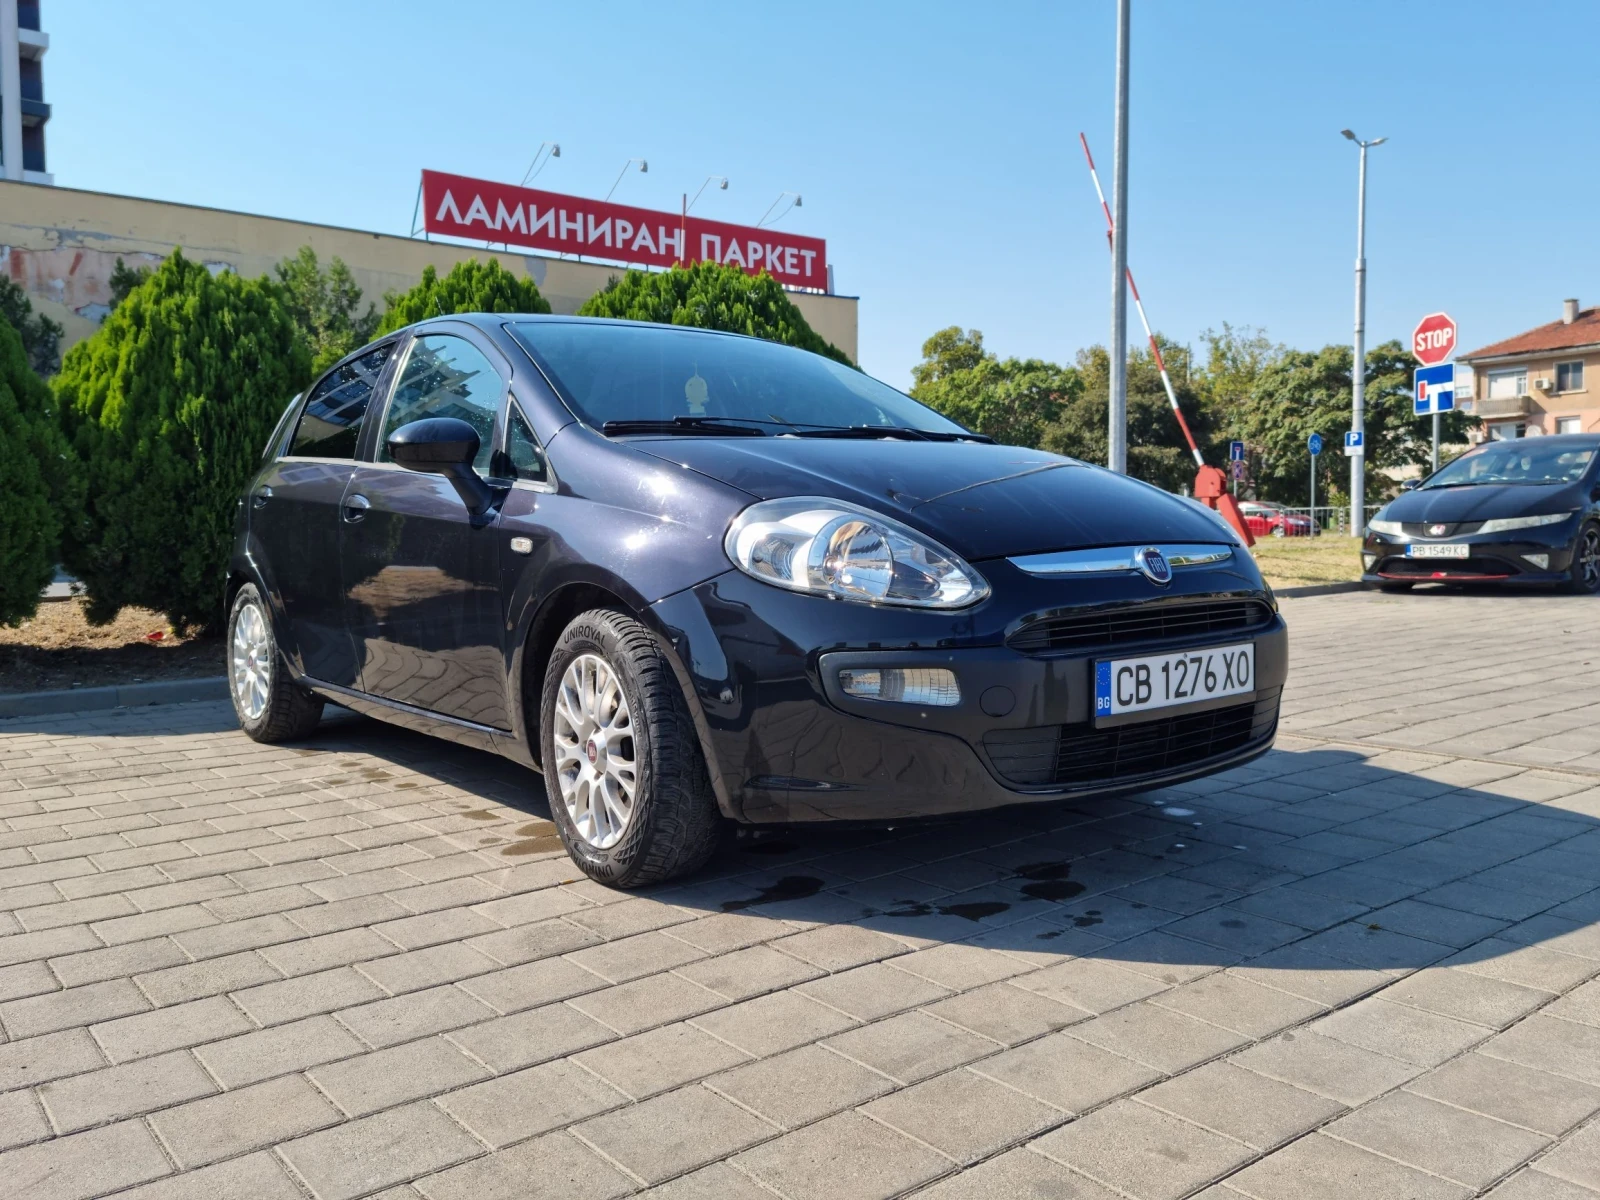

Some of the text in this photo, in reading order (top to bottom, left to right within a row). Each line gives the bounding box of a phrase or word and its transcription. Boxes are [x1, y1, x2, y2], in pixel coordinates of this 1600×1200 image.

[435, 189, 816, 277] ЛАМИНИРАН ПАРКЕТ
[1416, 327, 1453, 351] STOP
[1350, 433, 1359, 446] P
[564, 625, 606, 650] UNIROYAL
[1116, 650, 1250, 707] CB 1276 XO
[1097, 697, 1110, 710] BG
